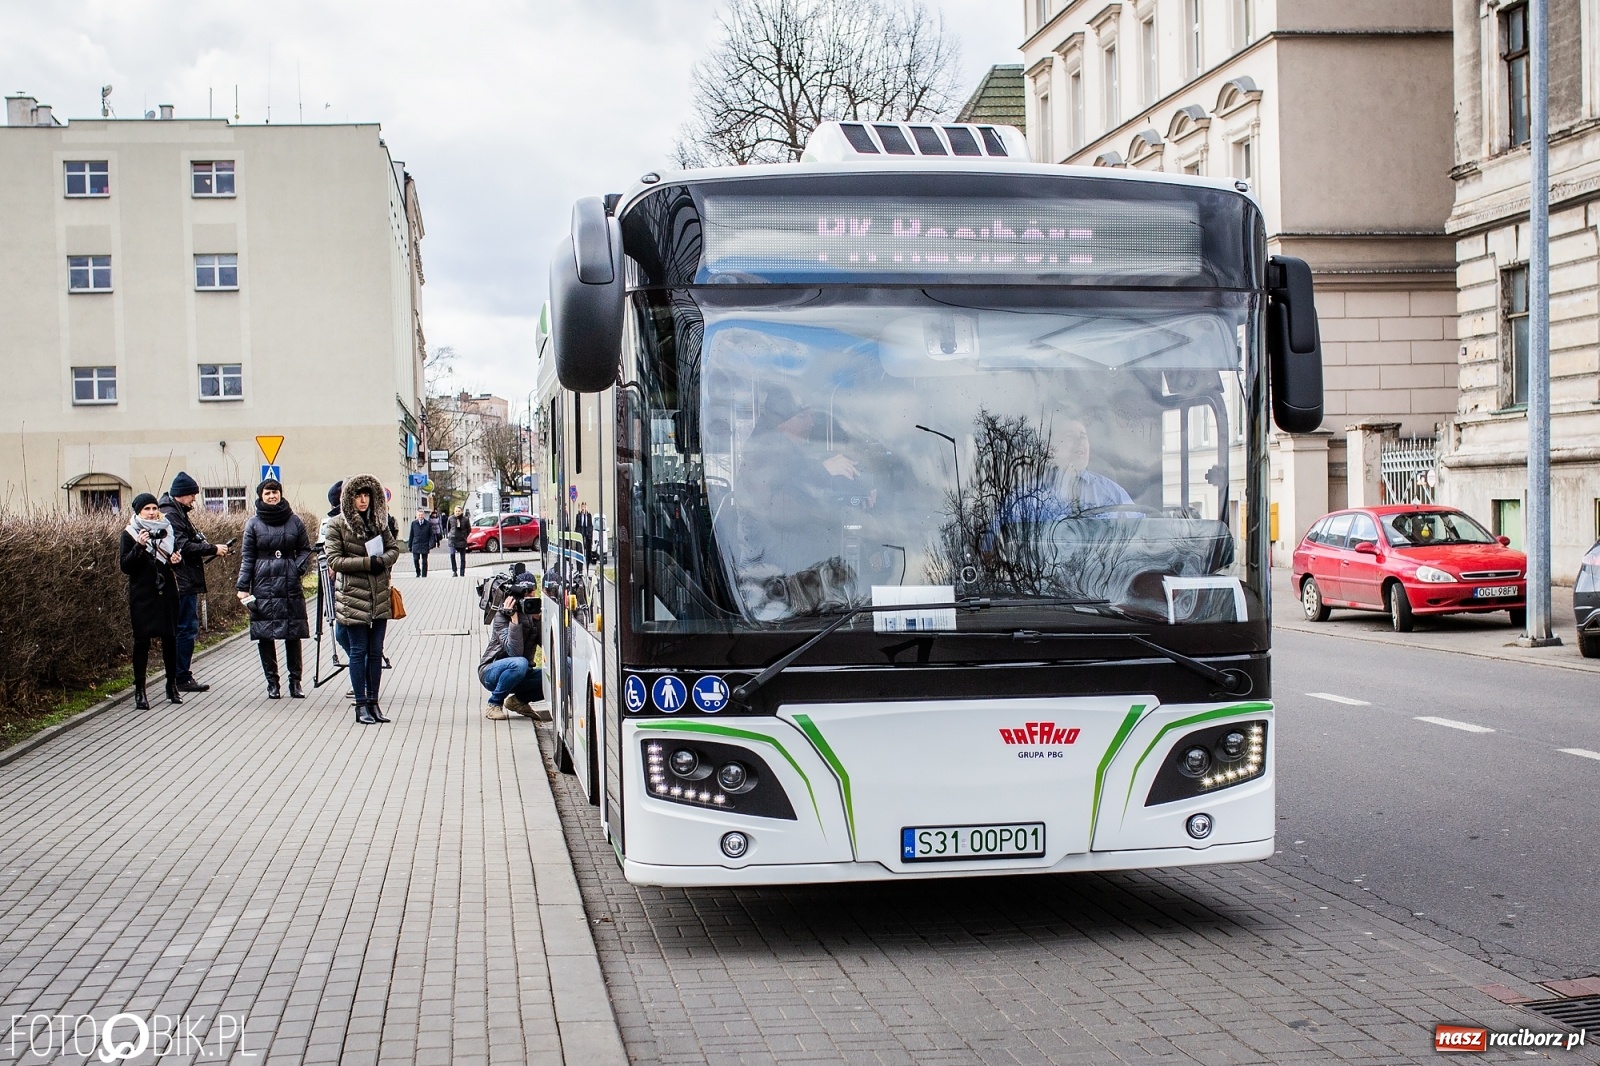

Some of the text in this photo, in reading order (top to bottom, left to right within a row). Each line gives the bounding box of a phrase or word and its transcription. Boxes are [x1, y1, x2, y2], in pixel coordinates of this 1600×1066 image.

[1479, 588, 1496, 597] OGL
[998, 722, 1081, 745] RAFAKO
[1018, 751, 1063, 759] GRUPA PBG
[918, 830, 959, 855] S31
[905, 846, 914, 854] PL
